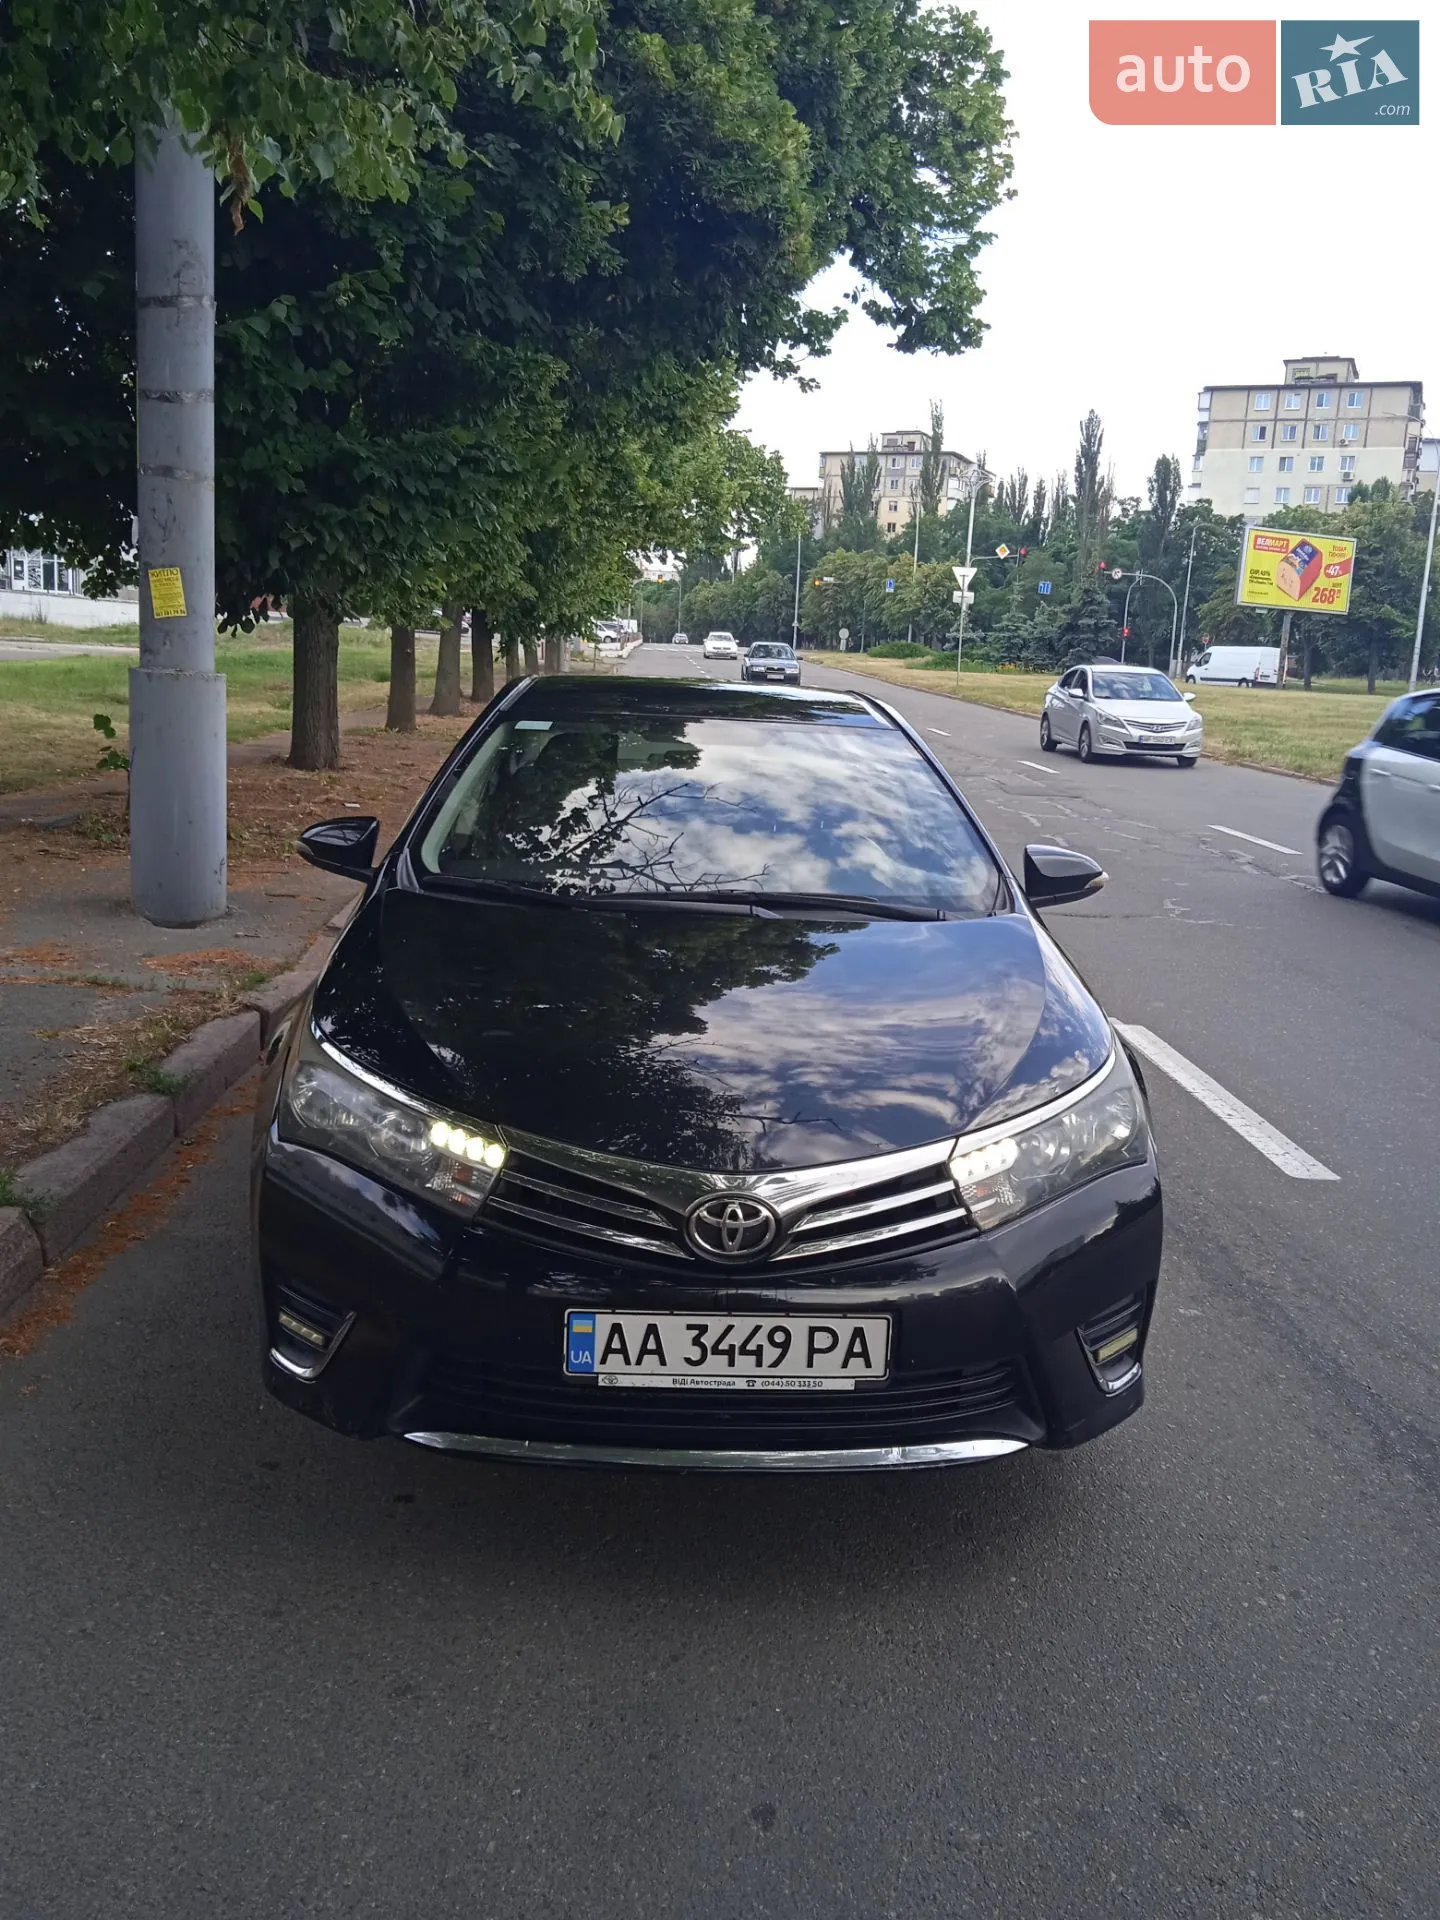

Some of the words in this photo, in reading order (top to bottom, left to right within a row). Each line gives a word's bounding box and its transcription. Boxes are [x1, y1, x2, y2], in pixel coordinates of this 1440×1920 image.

[599, 1323, 667, 1367] AA
[683, 1324, 793, 1369] 3449
[806, 1326, 872, 1369] PA
[571, 1350, 592, 1365] UA
[689, 1378, 736, 1388] Автострада
